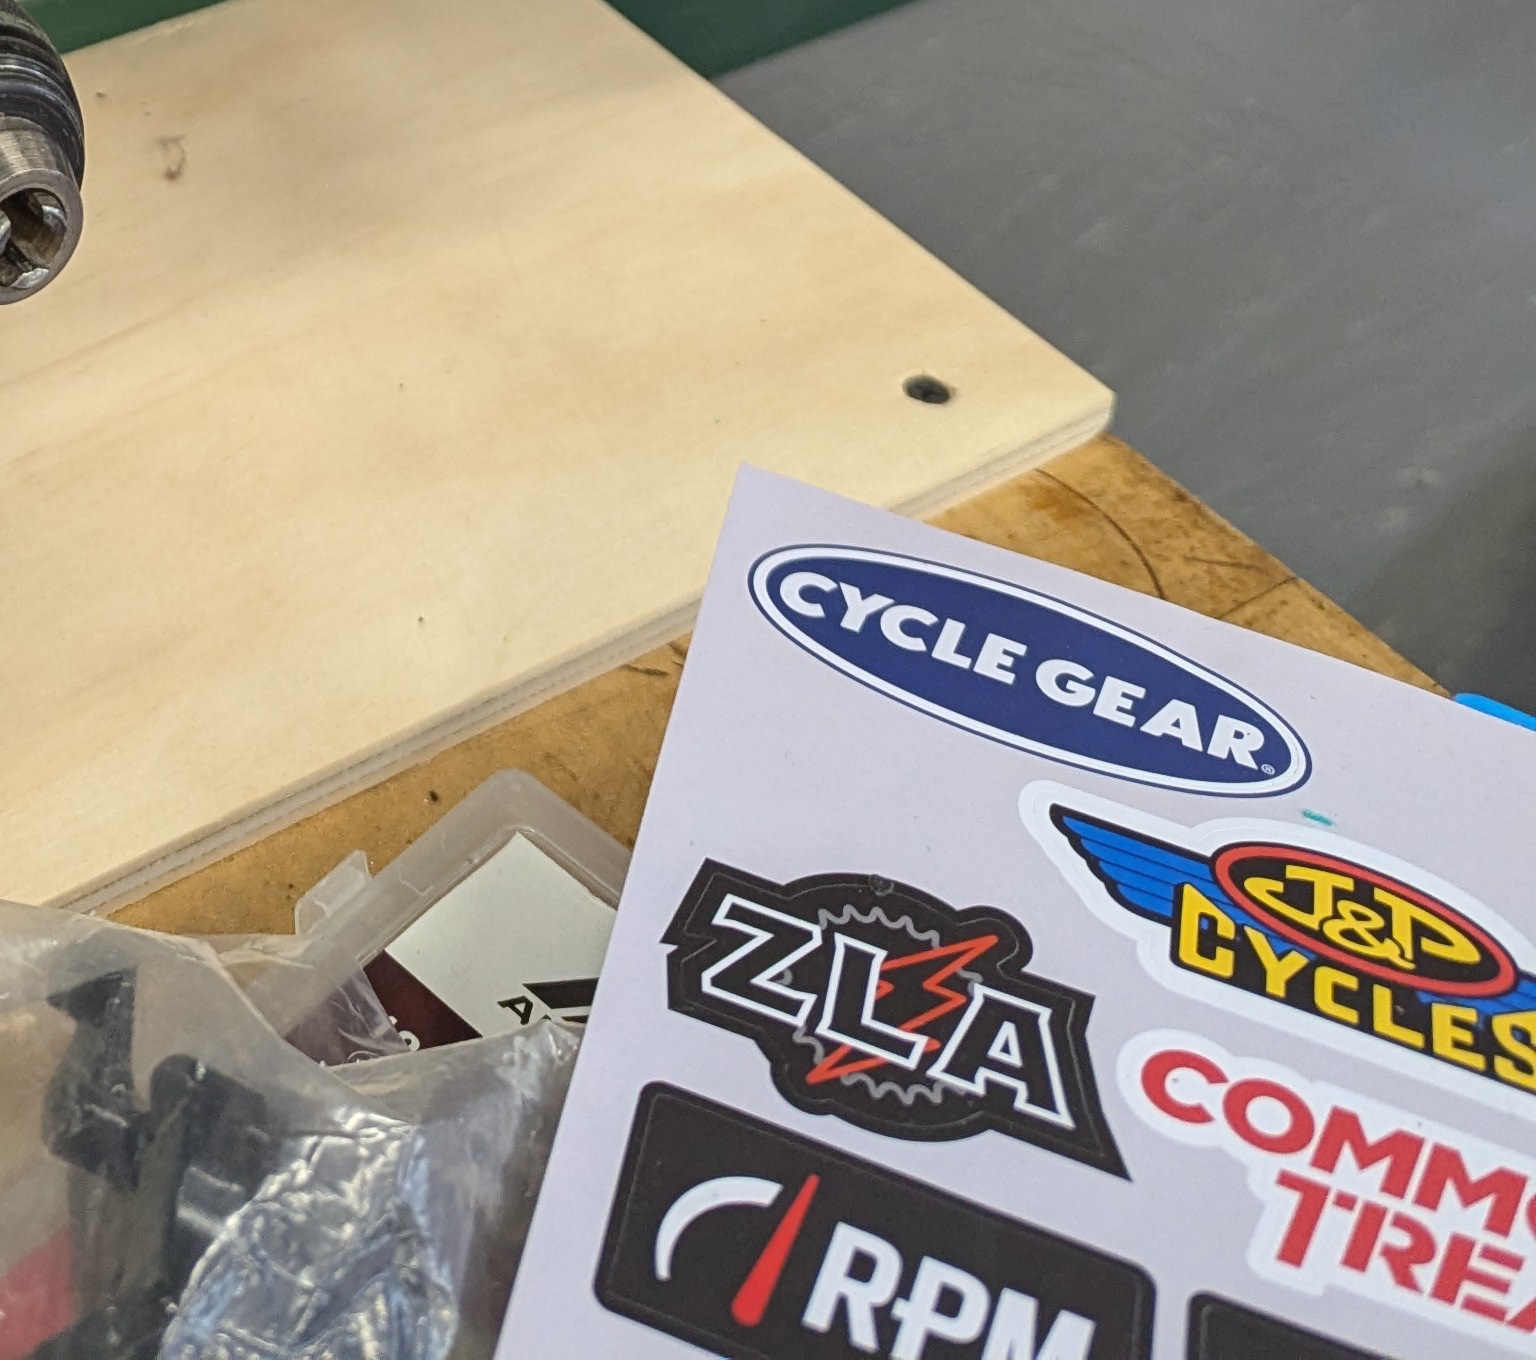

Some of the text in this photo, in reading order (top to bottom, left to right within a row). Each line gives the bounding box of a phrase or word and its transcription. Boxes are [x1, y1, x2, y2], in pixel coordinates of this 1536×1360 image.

[779, 571, 1265, 770] CYCLE GEAR
[701, 893, 1076, 1130] ZLA
[1178, 883, 1536, 1092] CYCLES
[1243, 864, 1481, 970] J&P
[1140, 1048, 1536, 1238] COMM
[801, 1221, 1096, 1360] RPM
